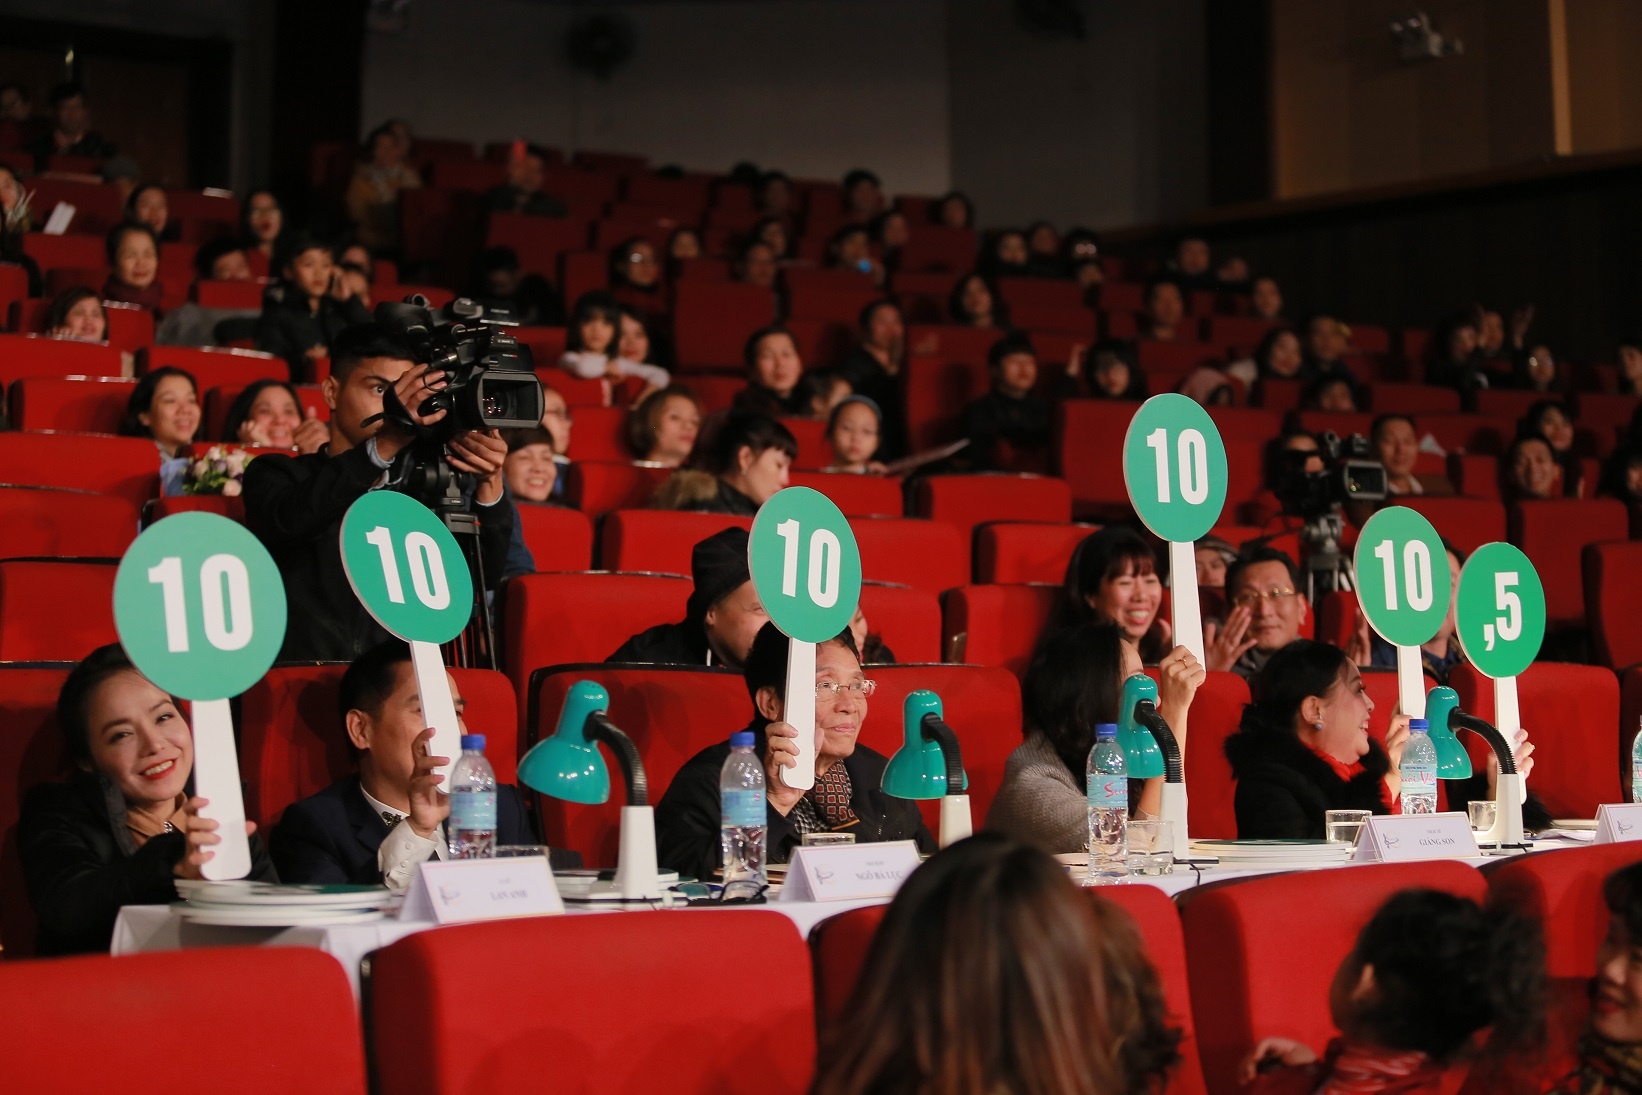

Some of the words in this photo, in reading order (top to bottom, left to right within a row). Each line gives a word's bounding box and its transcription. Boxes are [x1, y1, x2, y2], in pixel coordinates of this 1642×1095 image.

[1145, 427, 1209, 506] 10
[146, 552, 255, 654] 10
[365, 525, 451, 611] 10
[776, 517, 842, 609] 10
[1373, 538, 1435, 613] 10
[1483, 571, 1523, 652] ,5
